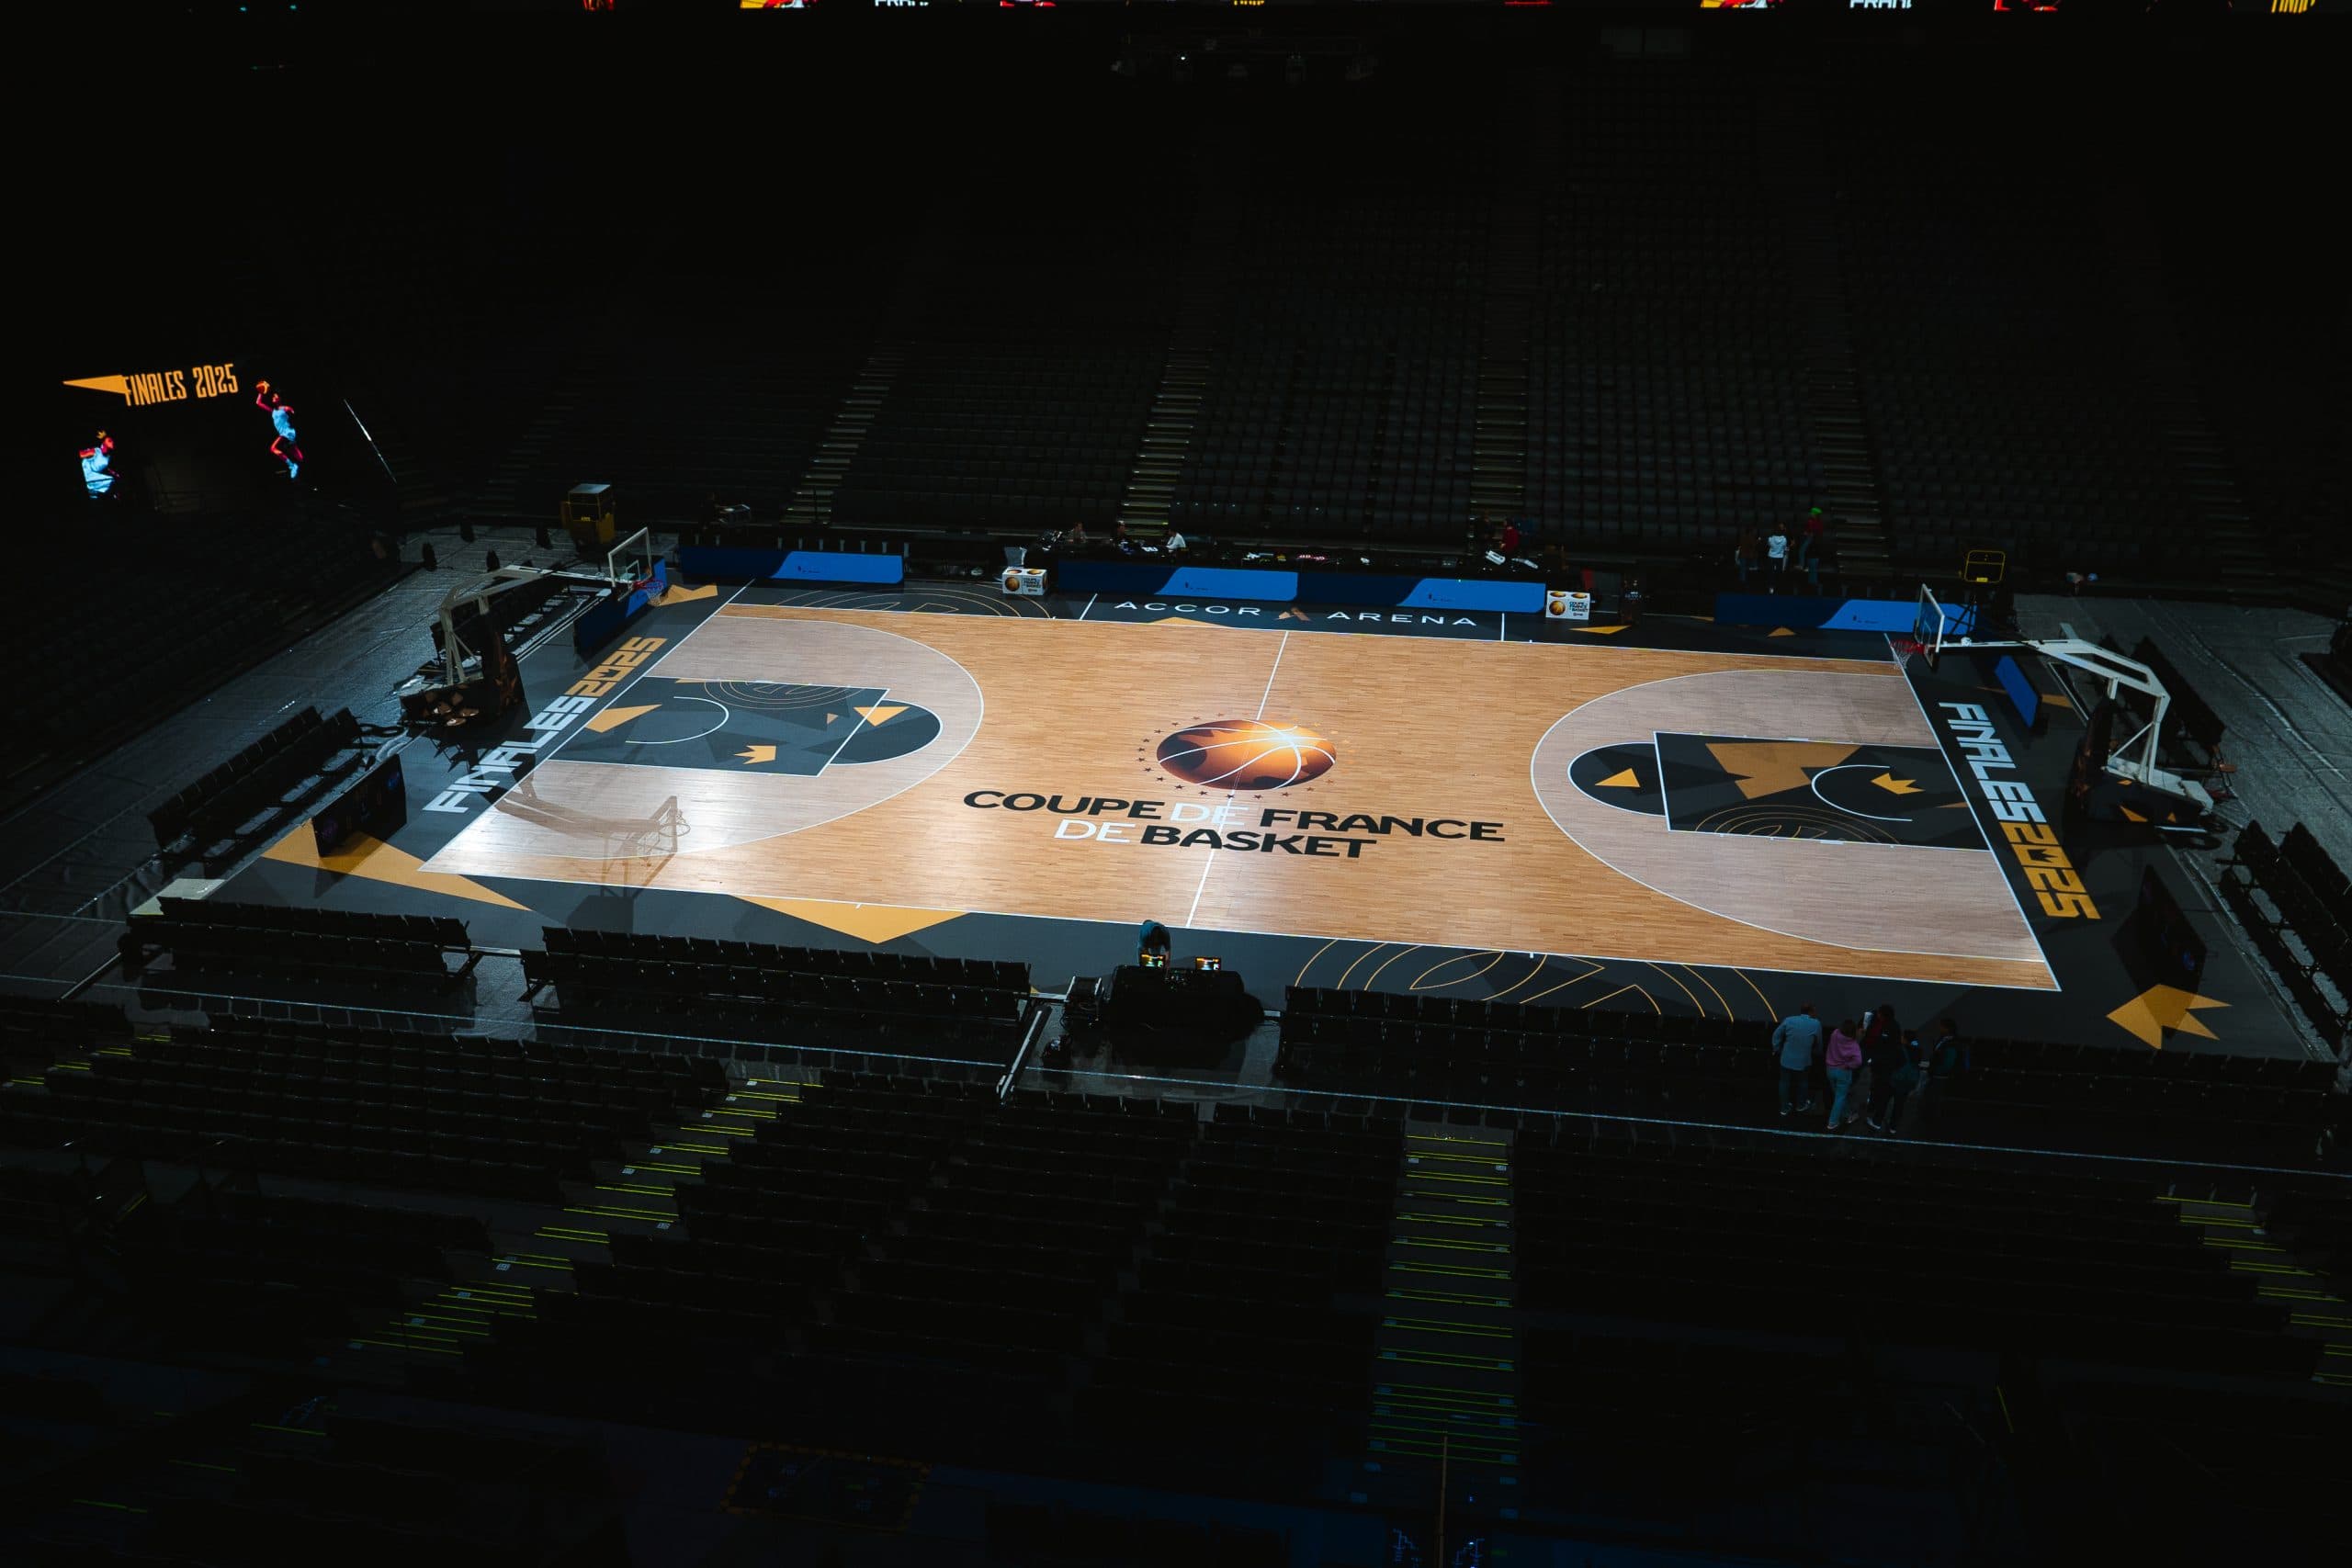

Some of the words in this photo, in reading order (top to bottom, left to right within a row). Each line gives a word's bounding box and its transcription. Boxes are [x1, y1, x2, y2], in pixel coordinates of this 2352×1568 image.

[124, 370, 187, 406] FINALES
[193, 364, 239, 398] 2025
[1114, 601, 1261, 616] ACCOR
[1327, 611, 1477, 626] ARENA
[964, 790, 1165, 820] COUPE
[1170, 802, 1248, 829] DE
[1261, 807, 1506, 841] FRANCE
[1054, 818, 1135, 843] DE
[1140, 824, 1377, 859] BASKET
